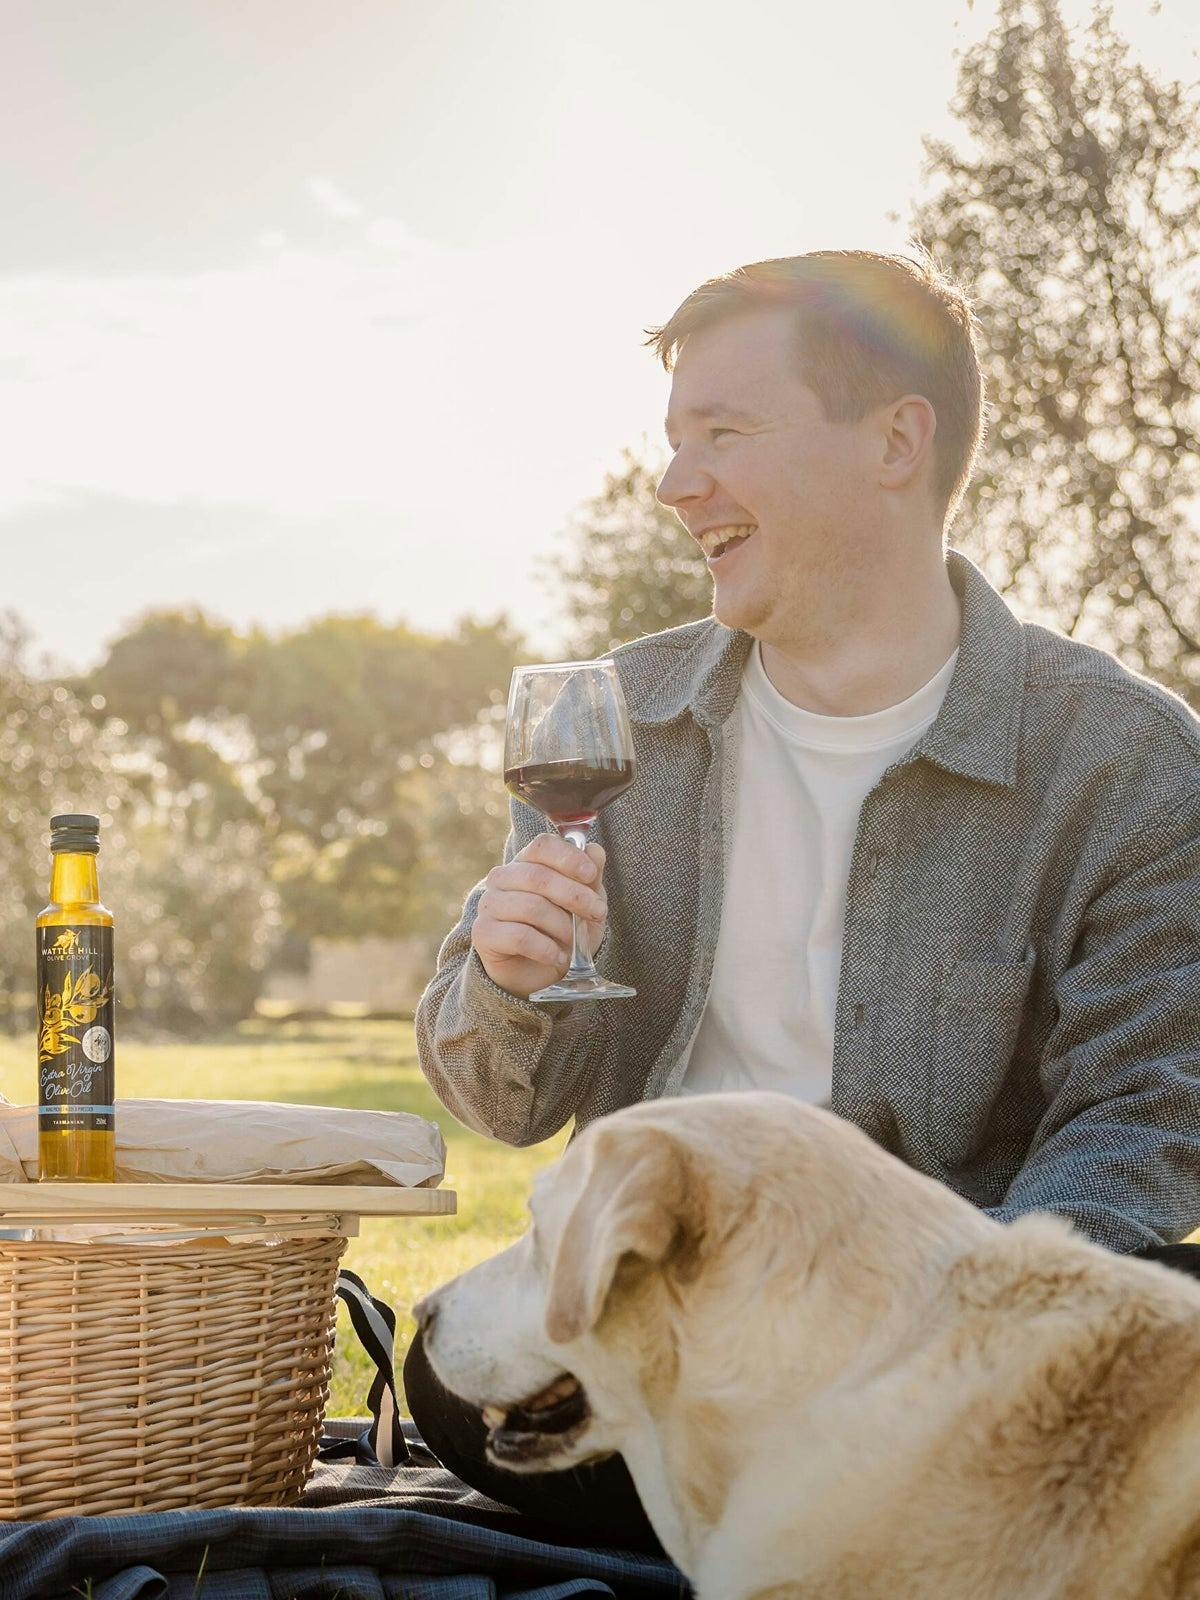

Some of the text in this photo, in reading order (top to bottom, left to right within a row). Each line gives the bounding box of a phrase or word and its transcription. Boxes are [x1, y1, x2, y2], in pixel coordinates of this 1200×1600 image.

[40, 1062, 103, 1087] Extra Virgin
[45, 1080, 92, 1100] Olive Oil
